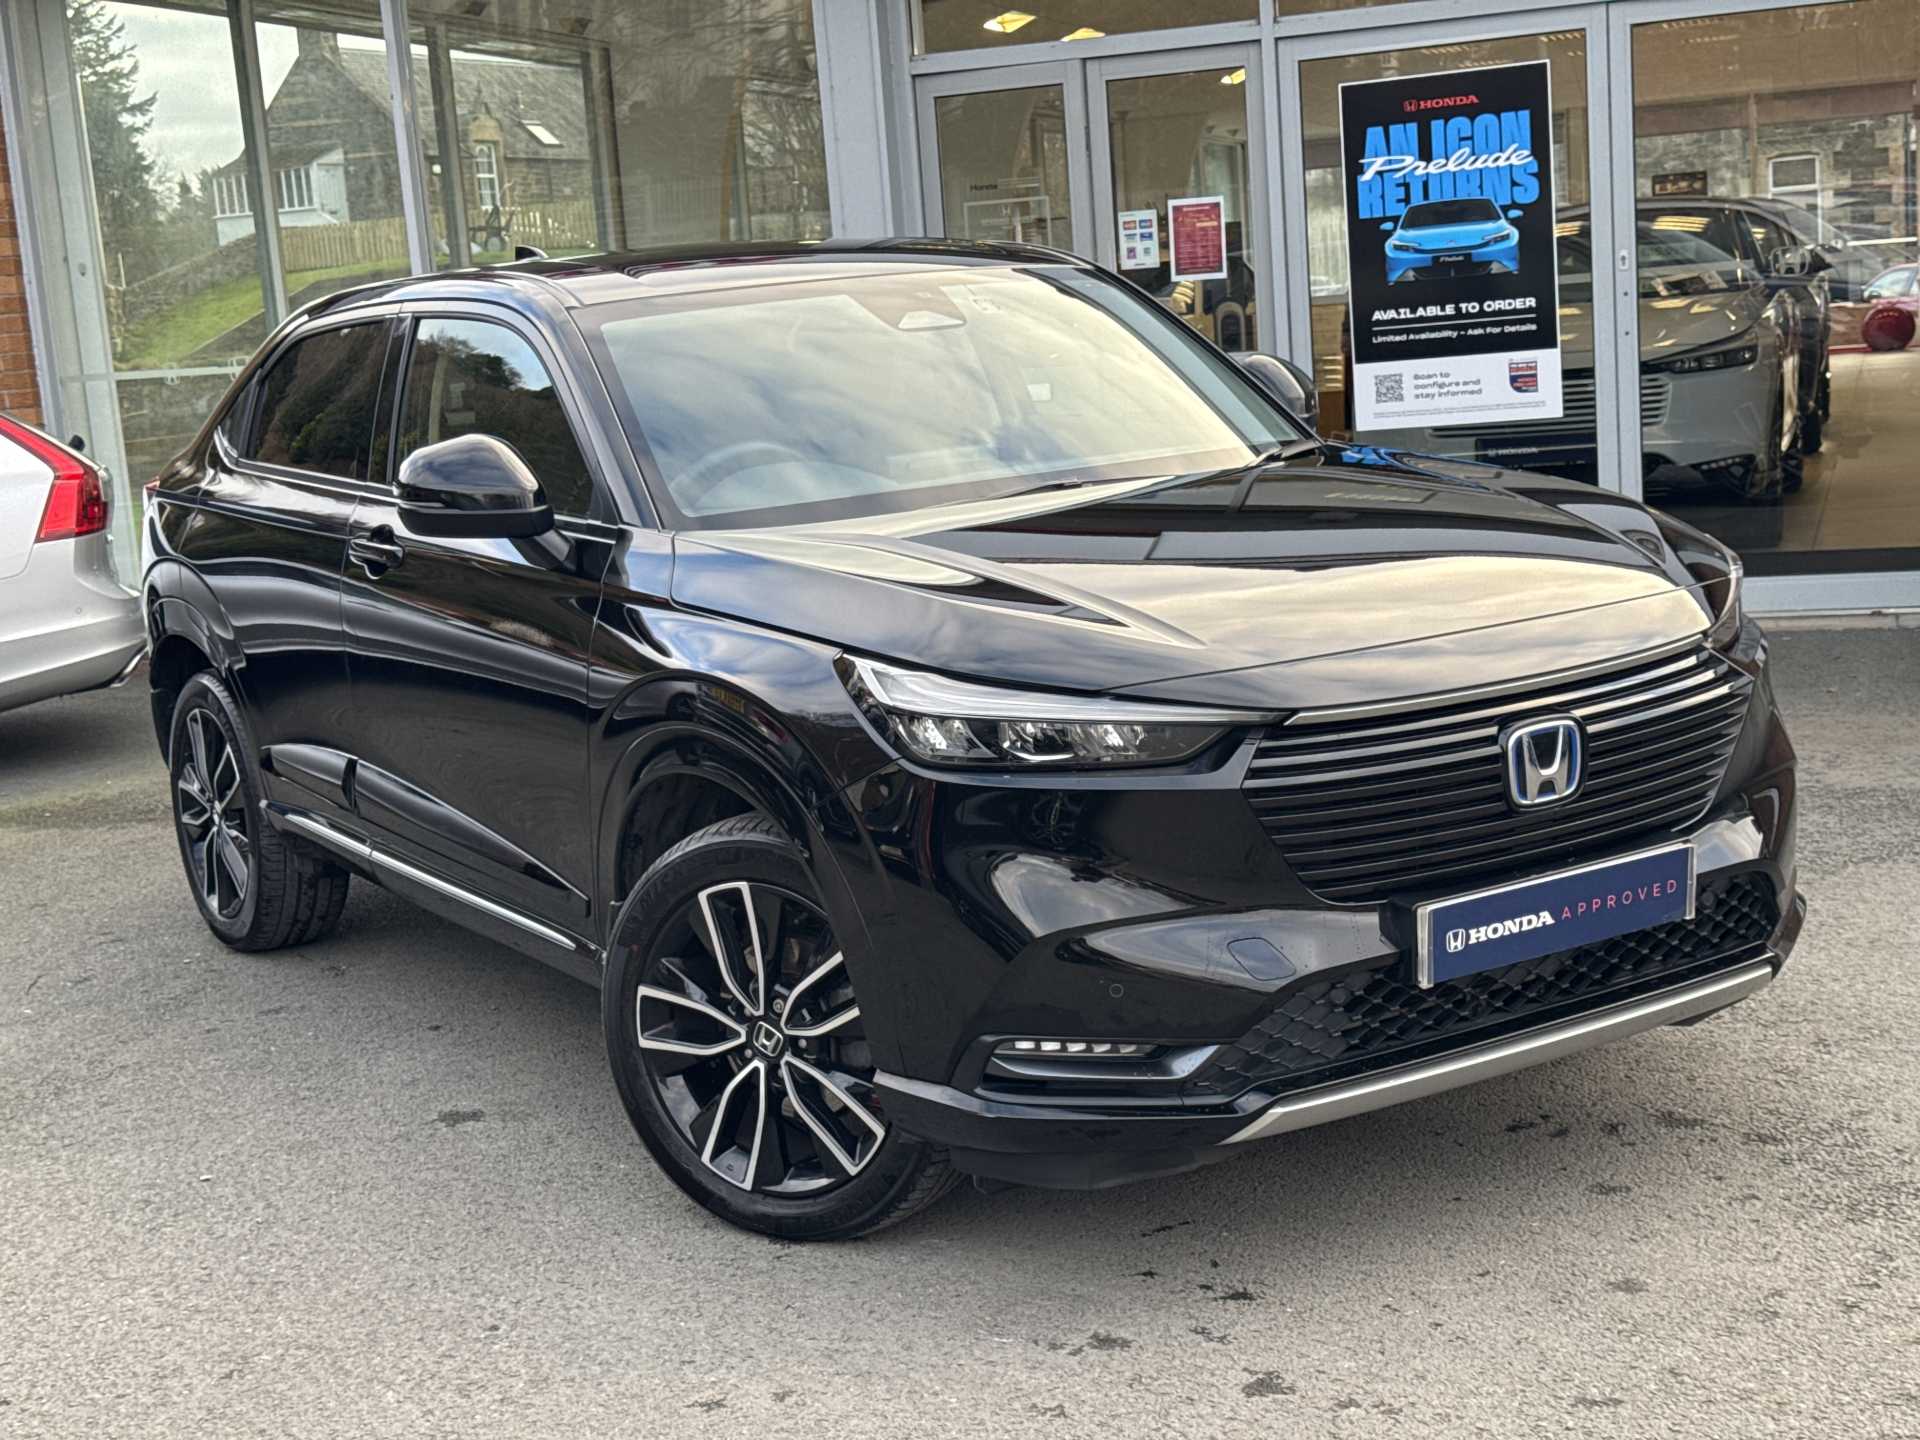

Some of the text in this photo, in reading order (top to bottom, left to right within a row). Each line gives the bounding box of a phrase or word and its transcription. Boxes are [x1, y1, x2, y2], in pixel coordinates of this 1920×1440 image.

[1419, 95, 1480, 110] HONDA
[1363, 109, 1532, 172] AN ICON
[1358, 143, 1534, 182] Prelude
[1357, 160, 1541, 219] RETURNS
[1371, 297, 1537, 322] AVAILABLE TO ORDER
[1372, 333, 1407, 344] Limited
[1408, 329, 1458, 341] Availability
[1467, 327, 1485, 336] Ask
[1486, 326, 1502, 334] For
[1504, 323, 1538, 333] Details
[1413, 371, 1451, 381] Scan to
[1413, 378, 1481, 391] configure and
[1413, 387, 1483, 400] stay informed
[1468, 878, 1678, 945] HONDA APPROVED
